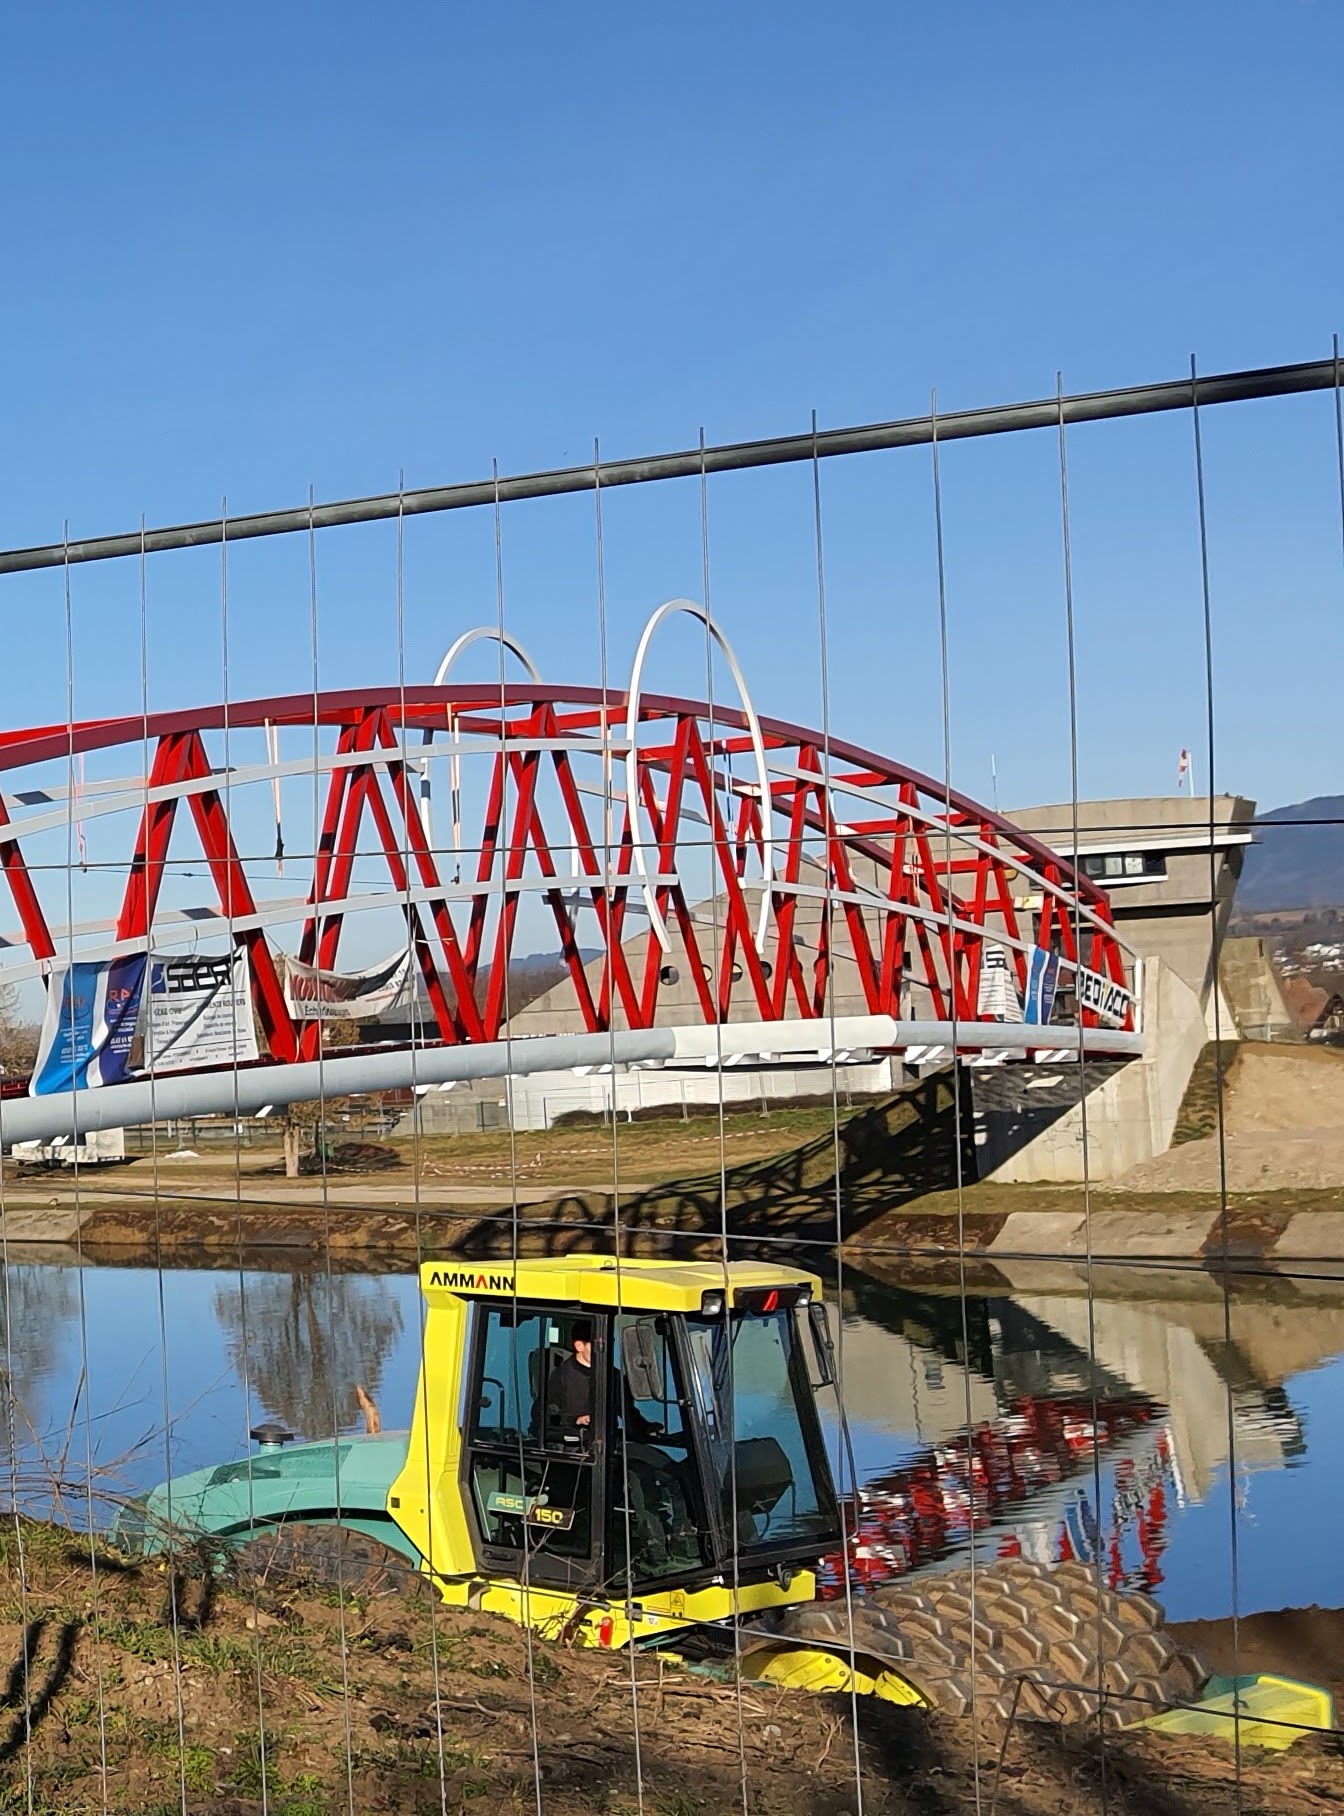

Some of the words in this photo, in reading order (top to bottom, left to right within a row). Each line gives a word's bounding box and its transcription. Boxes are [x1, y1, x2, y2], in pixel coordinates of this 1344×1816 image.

[430, 1271, 515, 1291] AMMANN
[495, 1497, 524, 1510] ASC
[535, 1508, 563, 1524] 150
